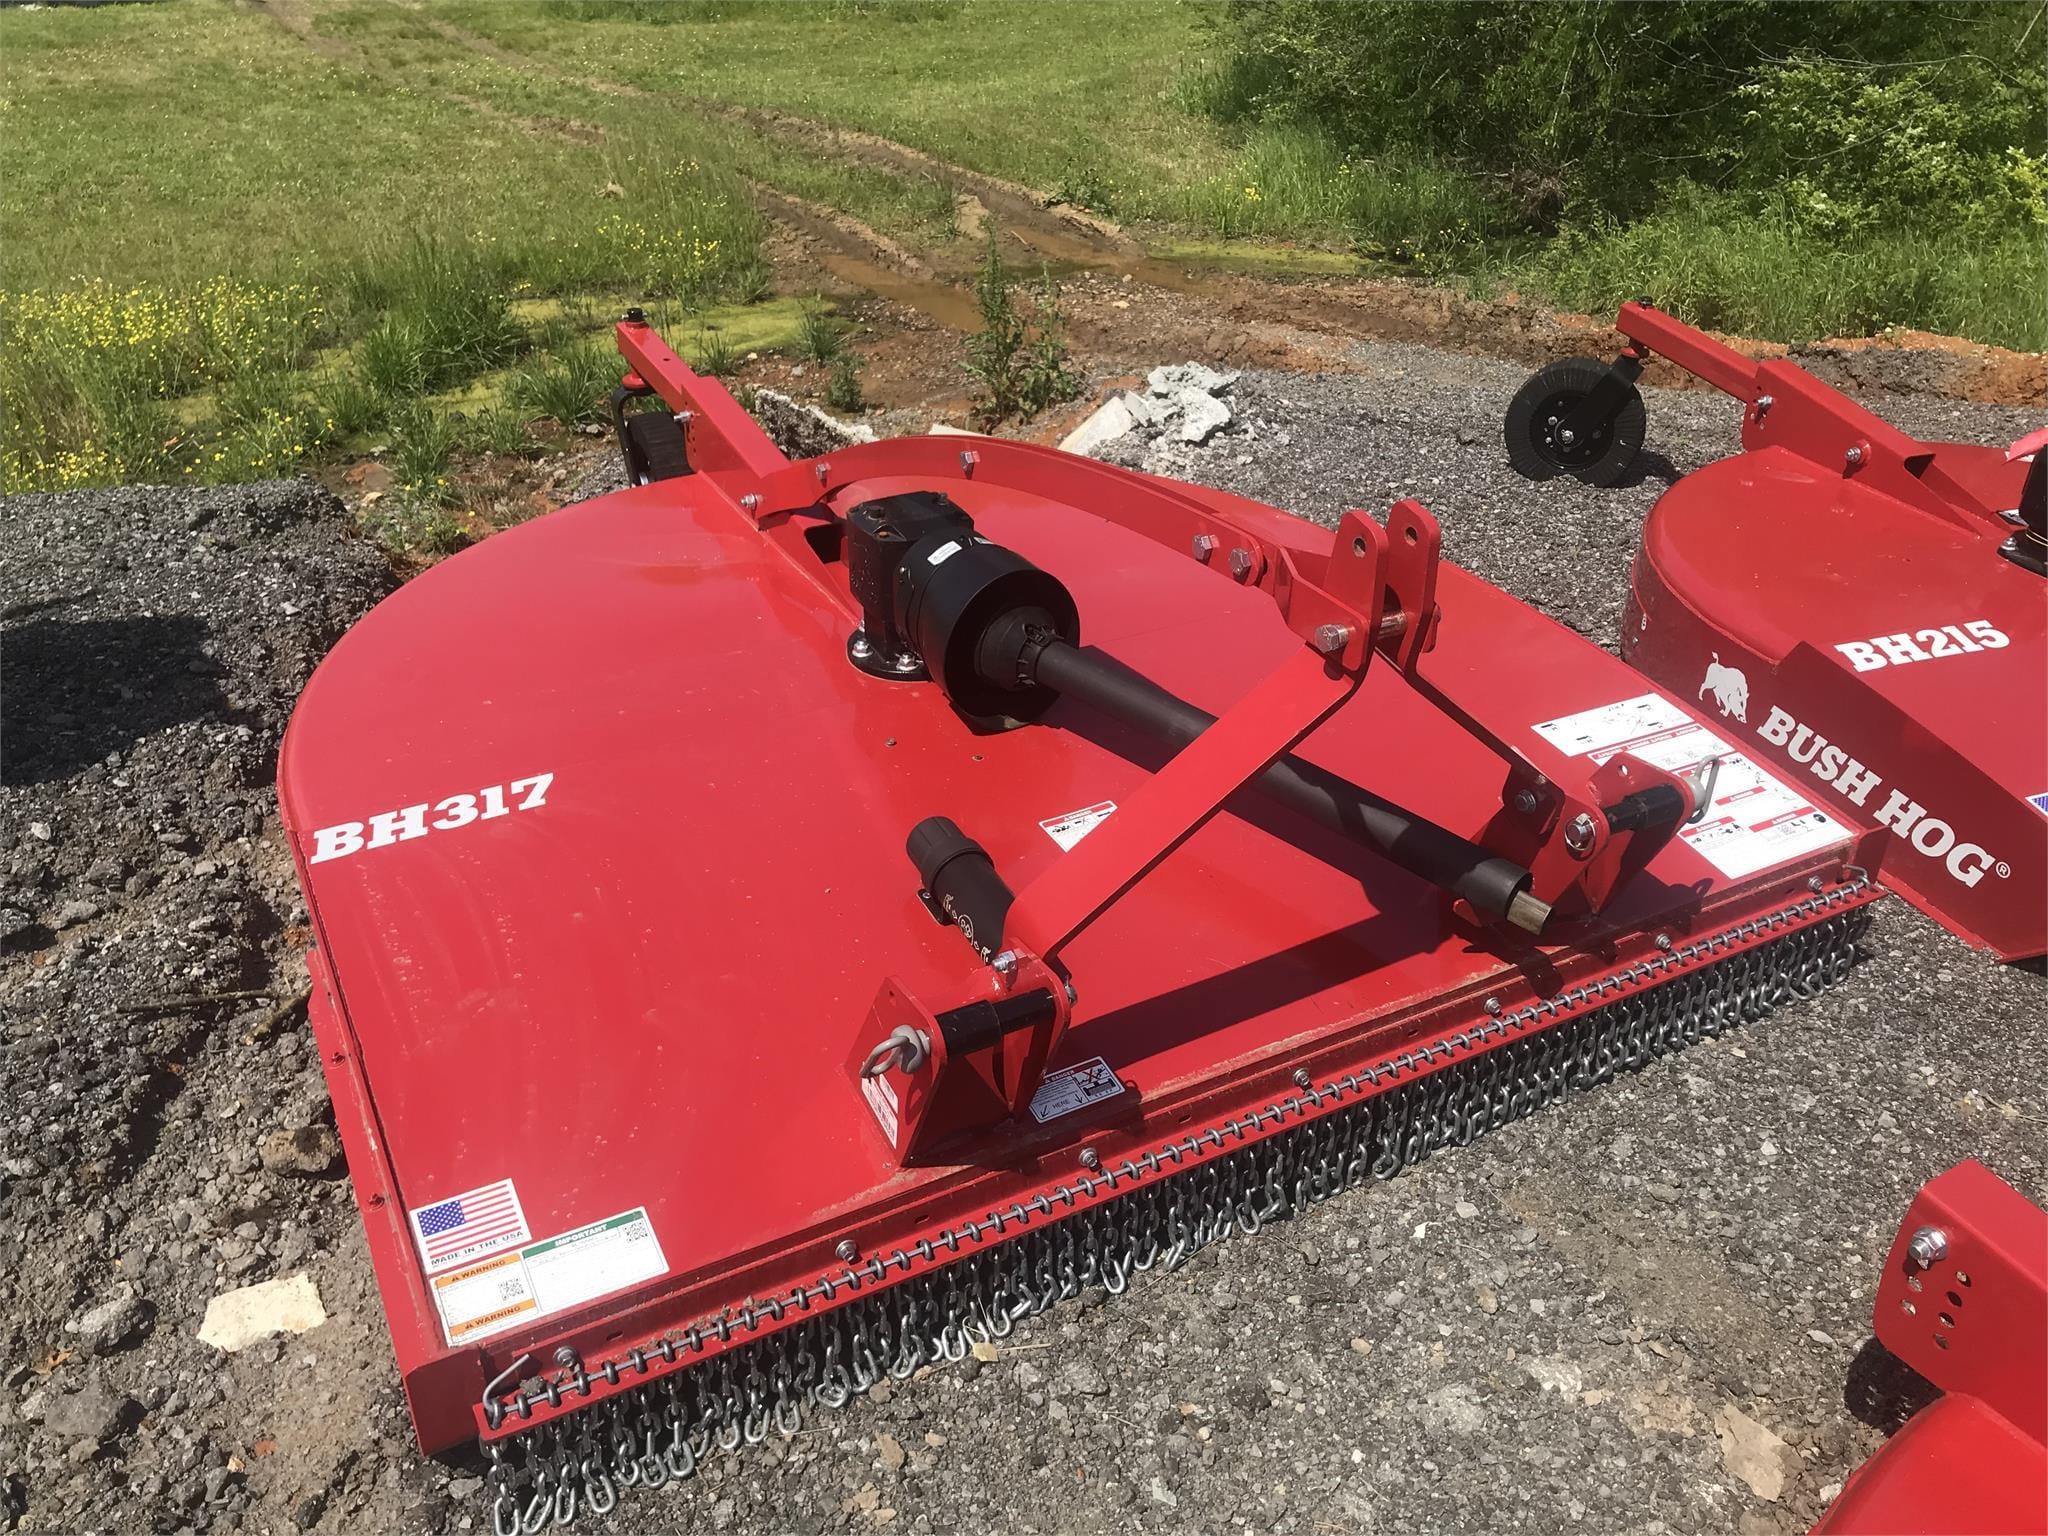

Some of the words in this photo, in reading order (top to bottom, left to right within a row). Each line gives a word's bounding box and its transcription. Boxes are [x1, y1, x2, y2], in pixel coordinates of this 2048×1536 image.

[1832, 619, 2010, 673] BH215
[1756, 705, 1882, 807] BUSH
[310, 772, 554, 865] BH317
[431, 1251, 461, 1266] MADE
[464, 1246, 475, 1254] IN
[479, 1239, 498, 1249] THE
[502, 1231, 524, 1242] USA
[554, 1223, 608, 1247] IMPORTANT
[461, 1260, 506, 1279] WARNING
[475, 1306, 521, 1325] WARNING
